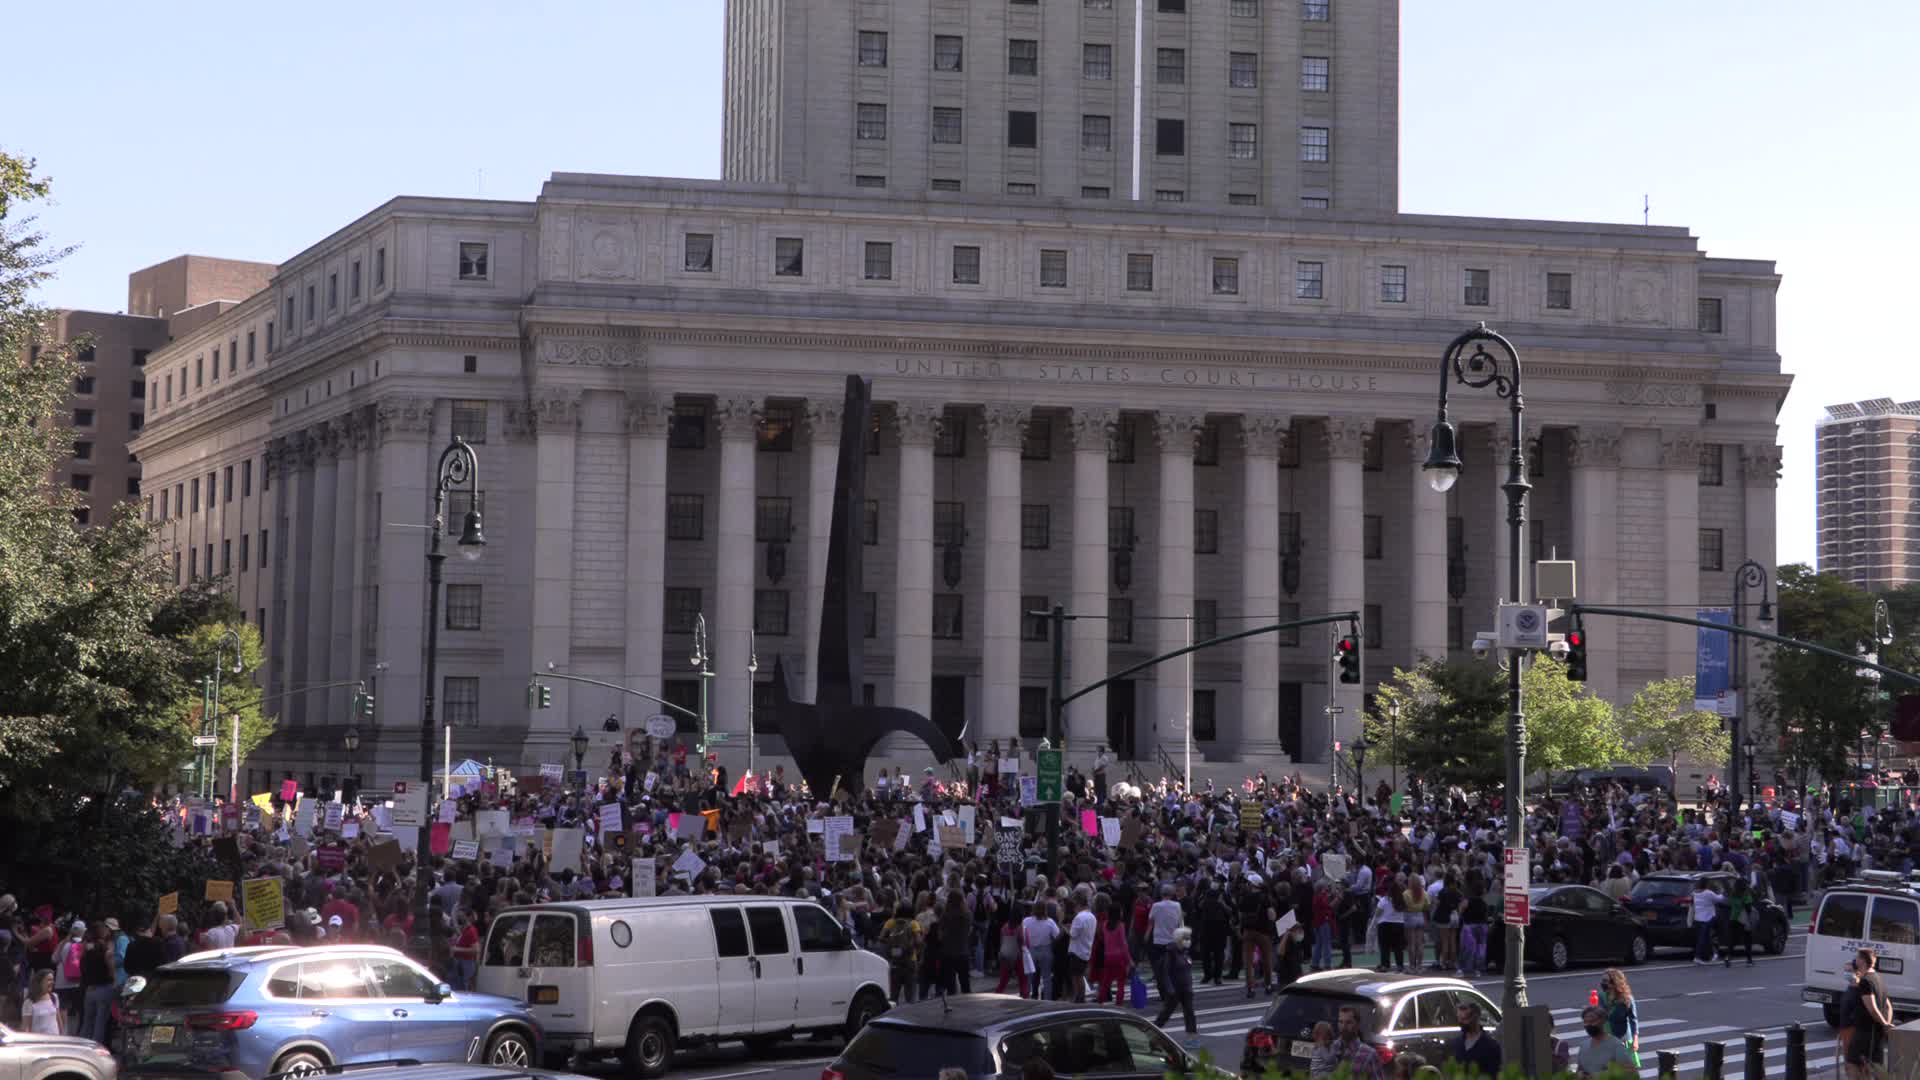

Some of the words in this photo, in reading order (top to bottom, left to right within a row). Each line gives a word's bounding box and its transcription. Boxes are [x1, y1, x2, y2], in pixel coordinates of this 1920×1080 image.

[895, 359, 1001, 377] UNITED
[1039, 364, 1130, 383] STATES
[1160, 368, 1257, 386] COURT
[1287, 372, 1377, 391] HOUSE
[1846, 940, 1886, 950] NYPD
